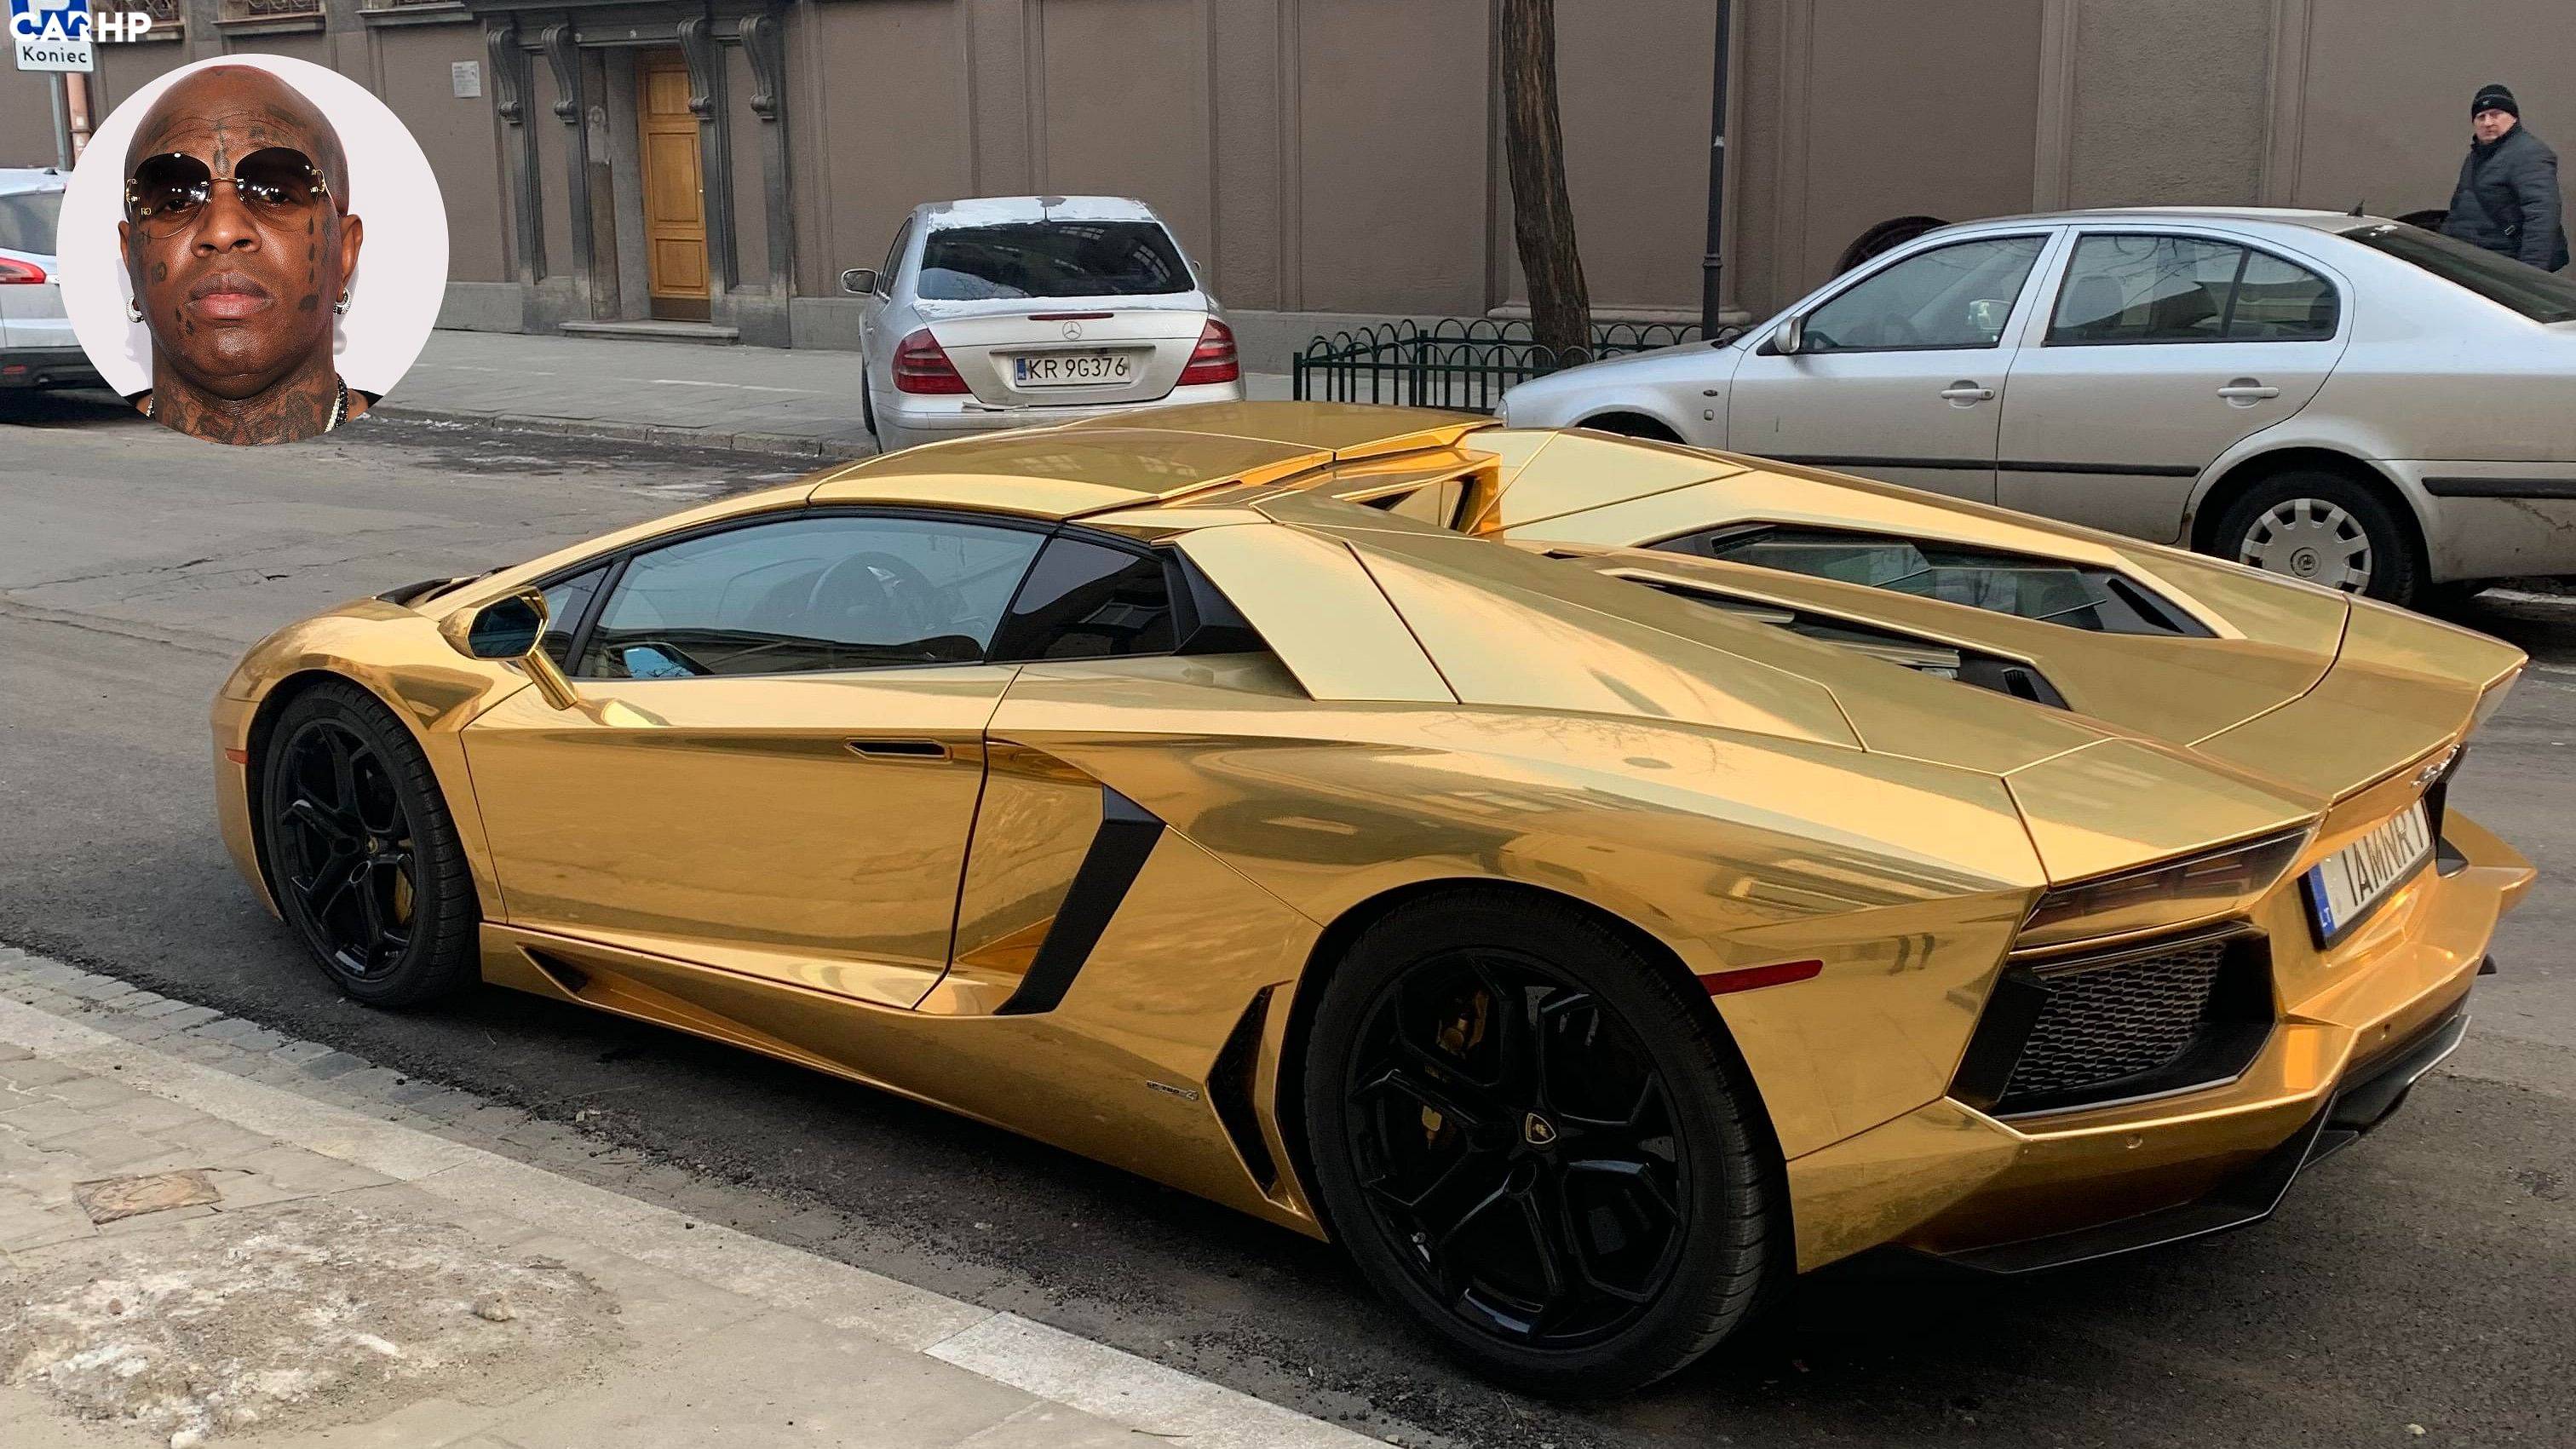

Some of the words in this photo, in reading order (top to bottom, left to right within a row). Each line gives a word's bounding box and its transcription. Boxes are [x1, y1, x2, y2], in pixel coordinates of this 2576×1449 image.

[22, 46, 87, 63] Koniec
[1029, 359, 1058, 379] KR
[1065, 358, 1125, 377] 9G376
